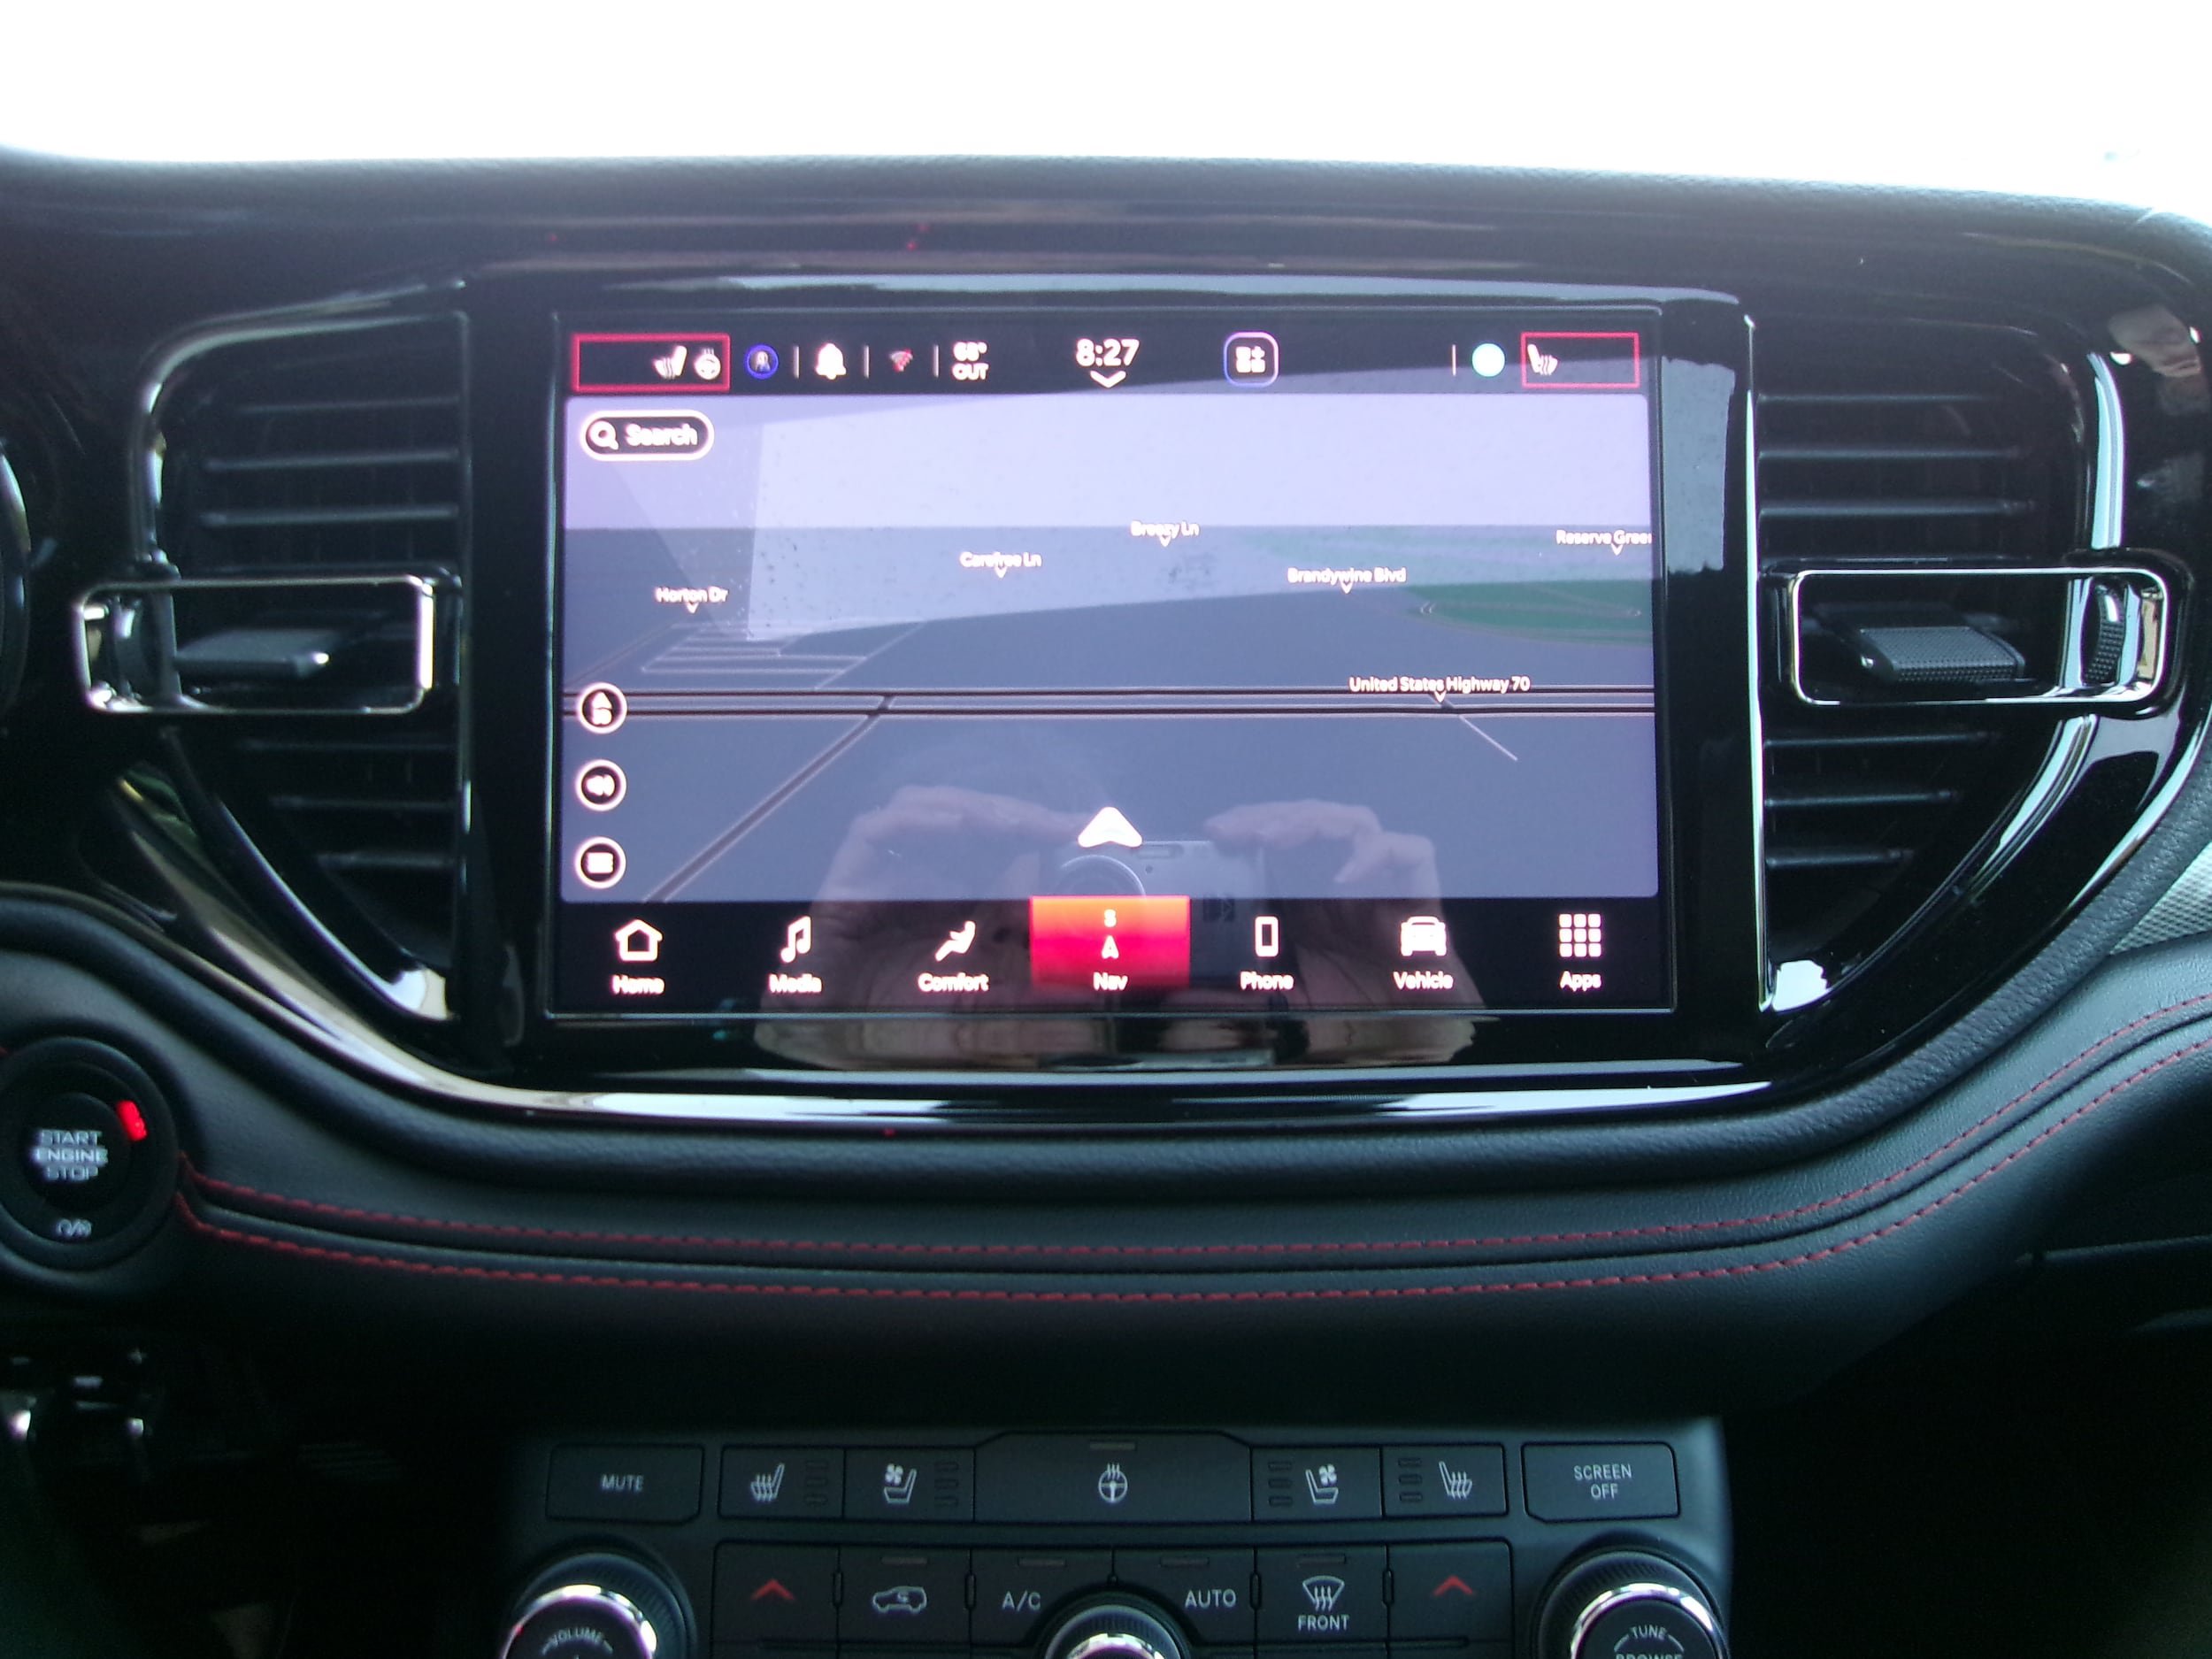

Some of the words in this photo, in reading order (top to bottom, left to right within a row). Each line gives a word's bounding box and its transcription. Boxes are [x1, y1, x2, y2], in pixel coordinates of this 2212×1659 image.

[1076, 338, 1140, 367] 8:27
[952, 363, 989, 380] OUT
[625, 423, 698, 446] Search
[1181, 520, 1200, 536] Ln
[1555, 529, 1612, 545] Reserve
[959, 551, 1022, 567] Carefree
[1023, 551, 1042, 567] Ln
[1287, 566, 1372, 586] Brandywine
[1373, 566, 1407, 583] Blvd
[655, 587, 708, 603] Horton
[709, 586, 728, 603] Dr
[1348, 676, 1399, 692] United
[1400, 676, 1445, 692] States
[1446, 675, 1509, 695] Highway
[1510, 676, 1531, 692] 70
[612, 974, 664, 995] Home
[769, 973, 822, 994] Media
[918, 972, 989, 992] Comfort
[1093, 972, 1128, 991] Nav
[1240, 972, 1294, 991] Phone
[1393, 971, 1454, 990] Vehicle
[1560, 971, 1602, 992] Apps
[38, 1129, 103, 1146] START
[34, 1147, 108, 1164] ENGINE
[47, 1165, 98, 1180] STOP
[1573, 1463, 1632, 1481] SCREEN
[601, 1474, 644, 1492] MUTE
[1590, 1483, 1619, 1500] OFF
[1002, 1592, 1041, 1611] A/C
[1185, 1589, 1237, 1609] AUTO
[1298, 1615, 1350, 1631] FRONT
[1630, 1624, 1667, 1640] TUNE
[549, 1626, 604, 1646] VOLUME
